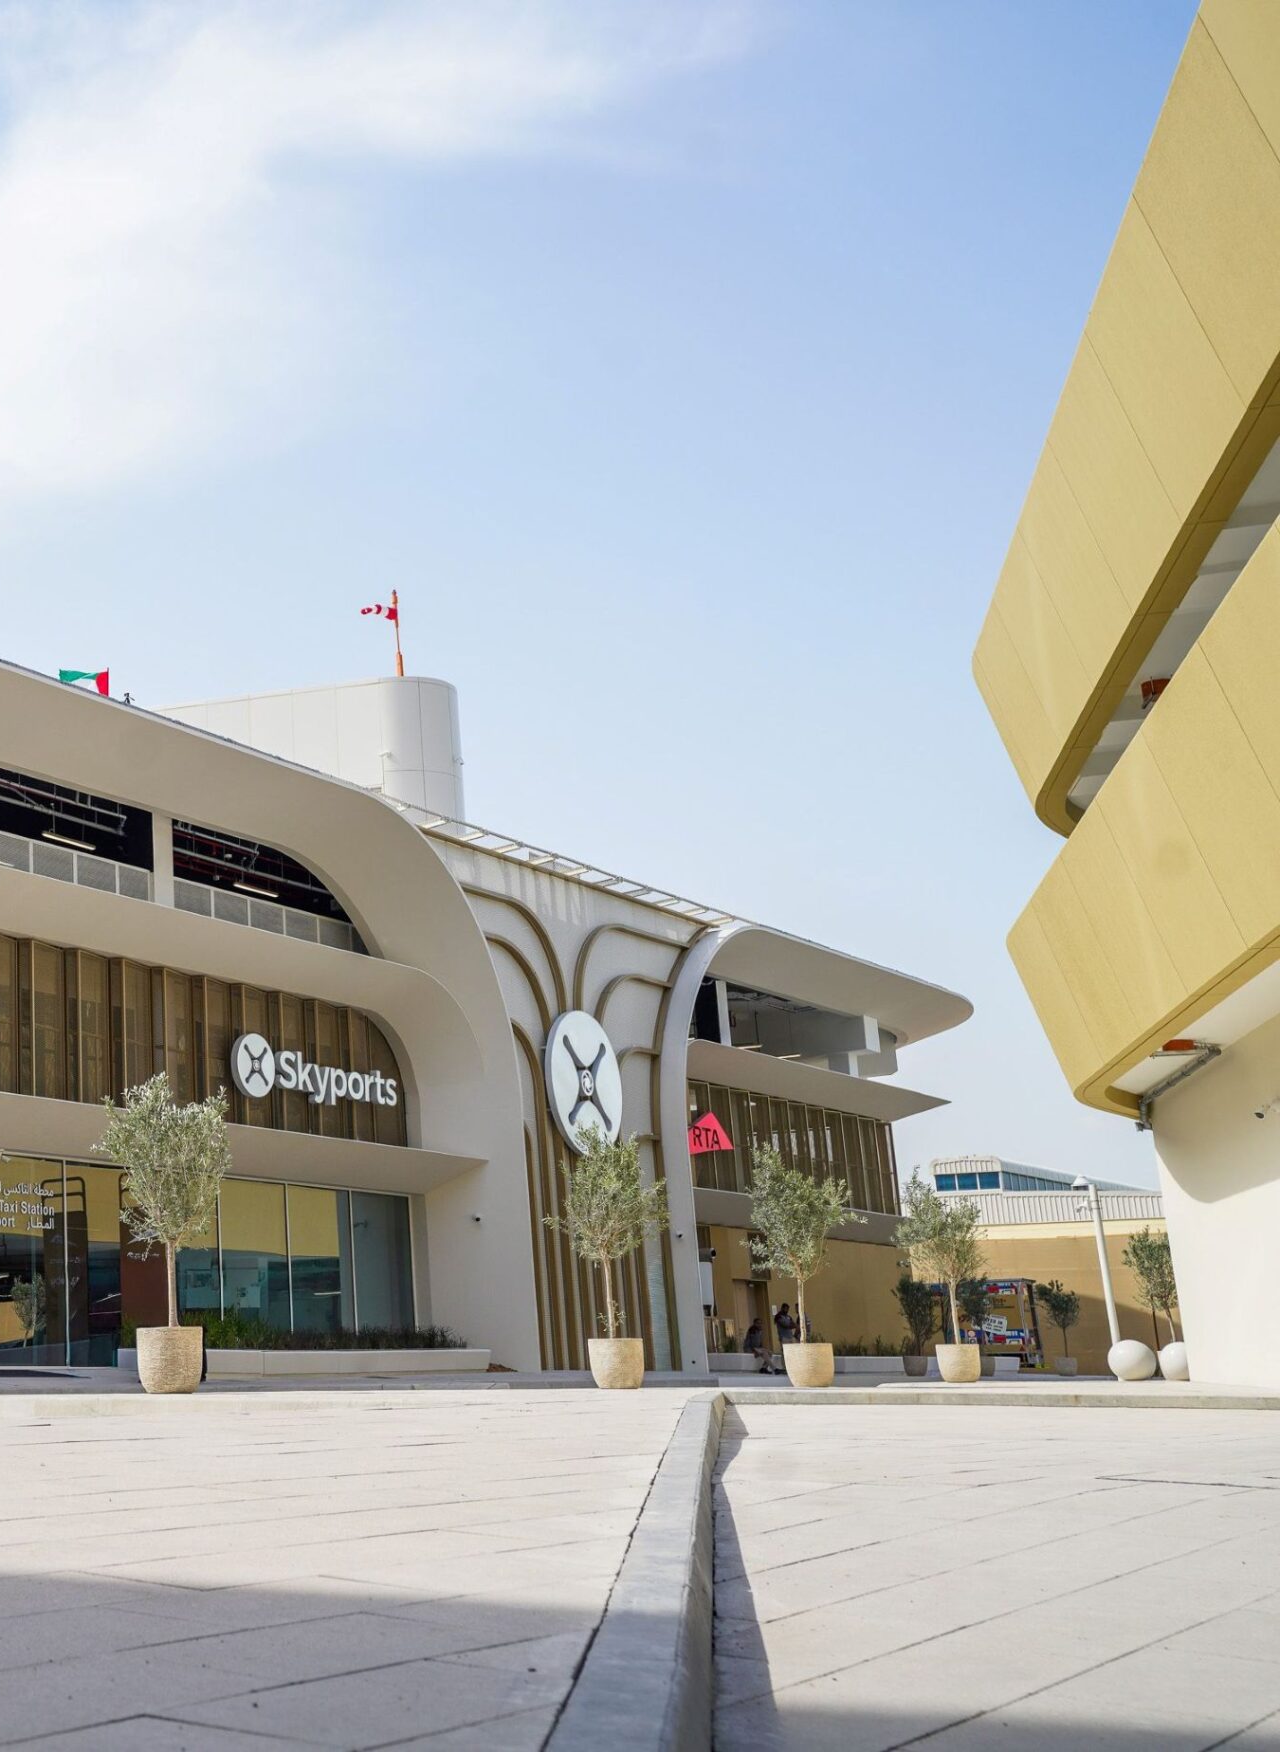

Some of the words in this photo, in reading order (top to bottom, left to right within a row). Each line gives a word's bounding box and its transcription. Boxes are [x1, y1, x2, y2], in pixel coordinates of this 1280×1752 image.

[278, 1051, 398, 1107] Skyports
[692, 1125, 722, 1150] RTA
[33, 1183, 54, 1197] محطة
[20, 1201, 55, 1217] Station
[26, 1216, 55, 1231] المطار
